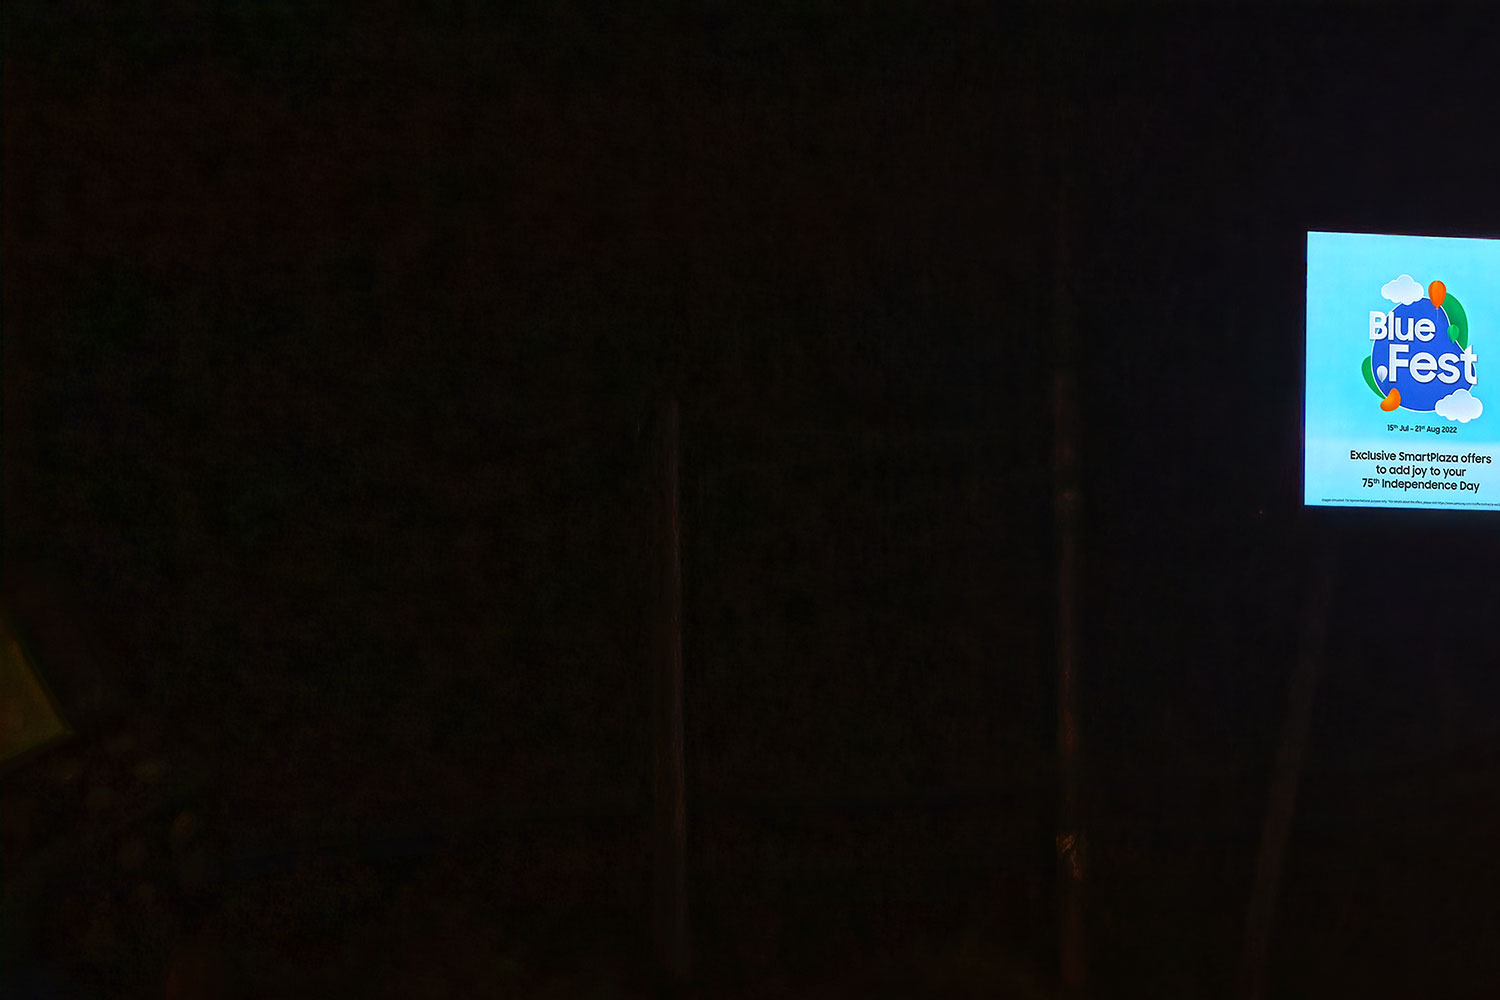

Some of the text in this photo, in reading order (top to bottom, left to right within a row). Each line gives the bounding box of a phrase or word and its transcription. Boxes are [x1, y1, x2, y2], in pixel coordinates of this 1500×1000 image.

[1369, 310, 1436, 343] Blue
[1389, 343, 1479, 386] Fest
[1386, 424, 1399, 432] 15th
[1415, 425, 1426, 433] 21st
[1426, 426, 1440, 435] Aug
[1350, 450, 1492, 464] Exclusive SmartPlaza offers
[1376, 465, 1467, 479] to add joy to your
[1362, 478, 1480, 494] 75th Independence Day
